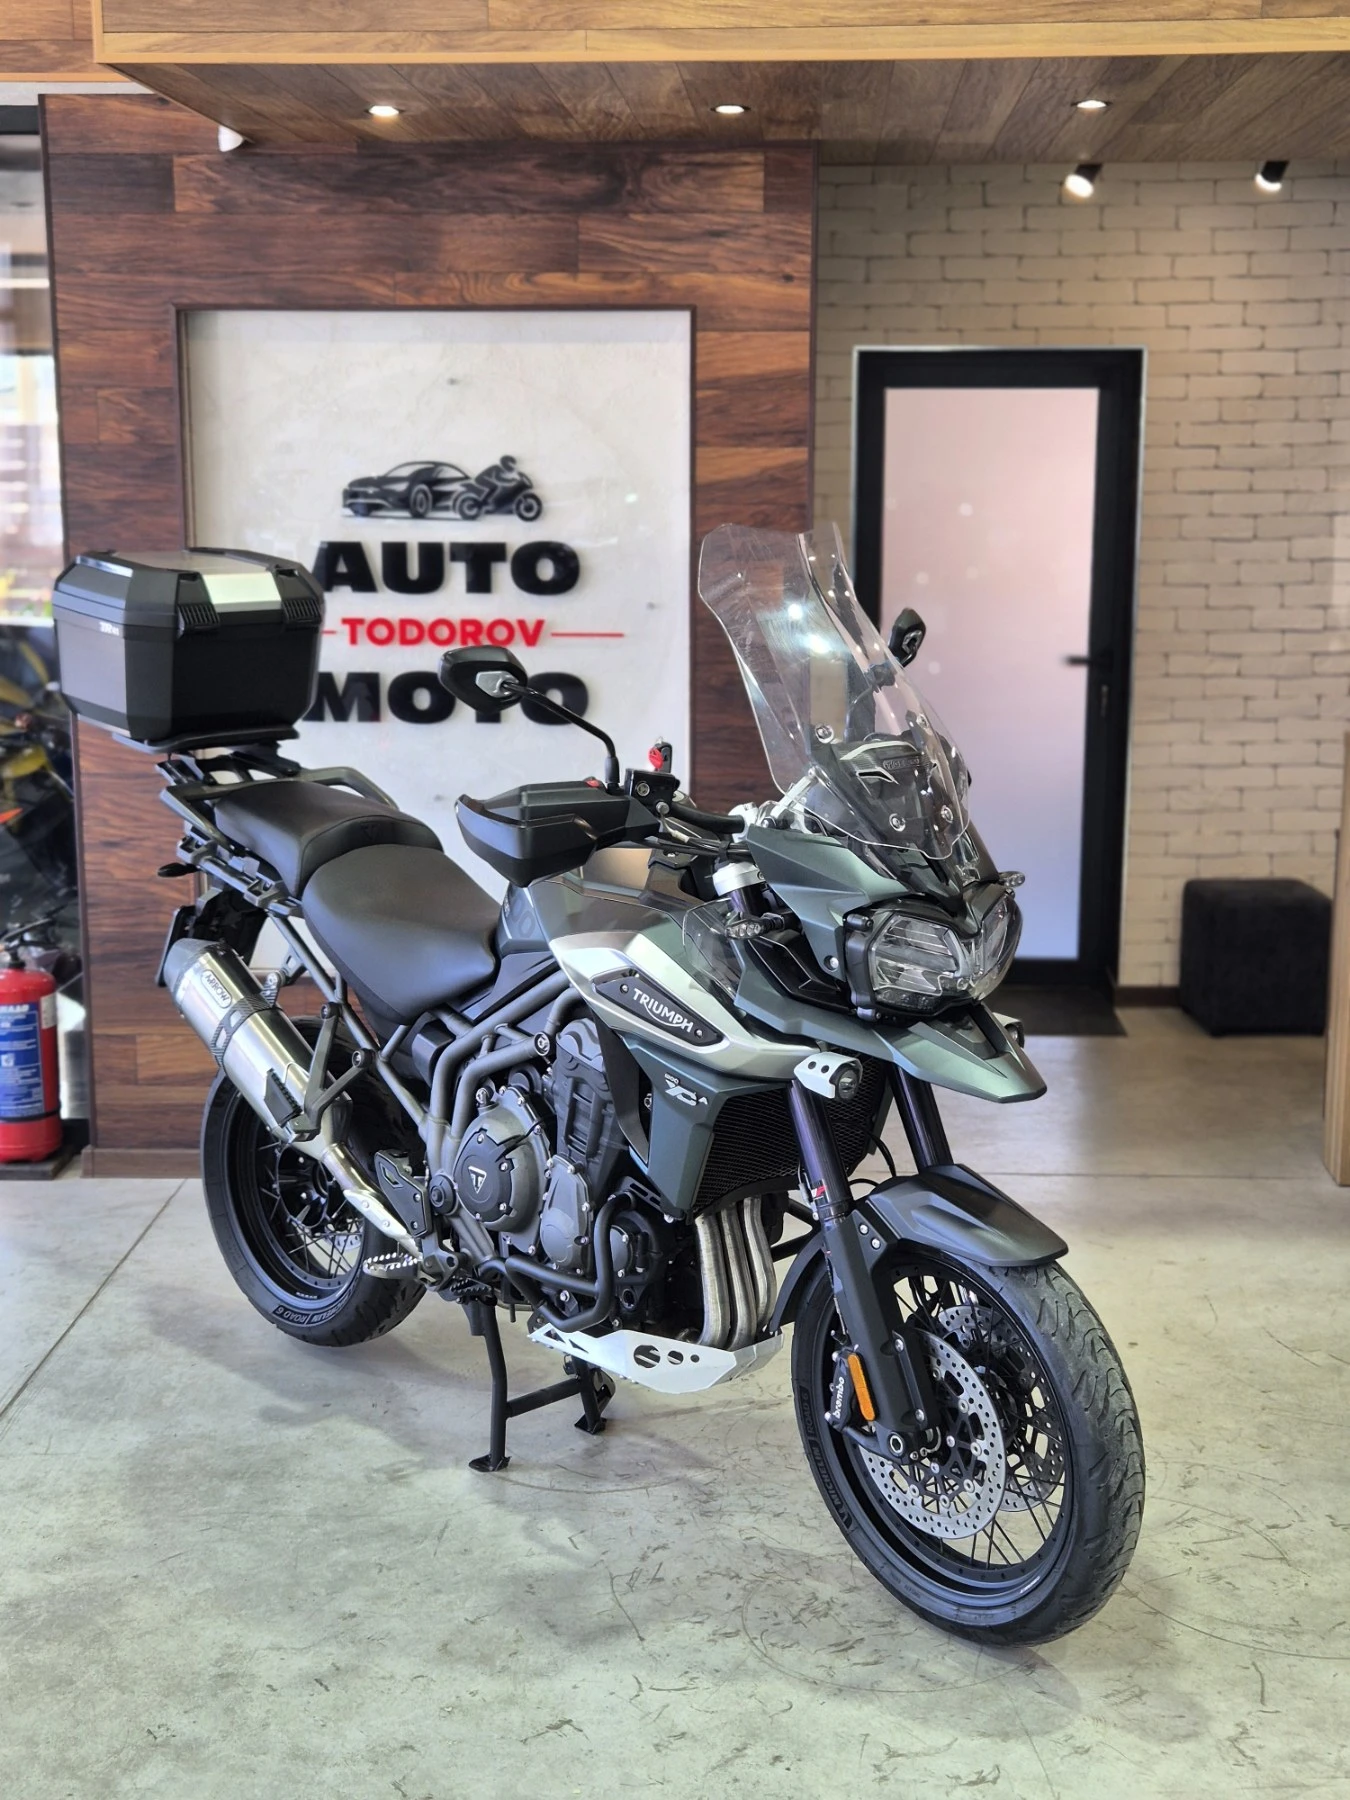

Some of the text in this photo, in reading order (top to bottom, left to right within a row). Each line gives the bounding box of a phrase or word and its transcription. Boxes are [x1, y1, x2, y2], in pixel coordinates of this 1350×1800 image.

[311, 541, 580, 595] AUTO
[342, 618, 545, 646] TODOROV
[302, 671, 589, 725] MOO
[633, 988, 693, 1032] TRIUMPH
[276, 1306, 284, 1314] 6
[284, 1311, 307, 1323] ROAD
[832, 1377, 844, 1419] brembo
[803, 1402, 815, 1433] ROAD
